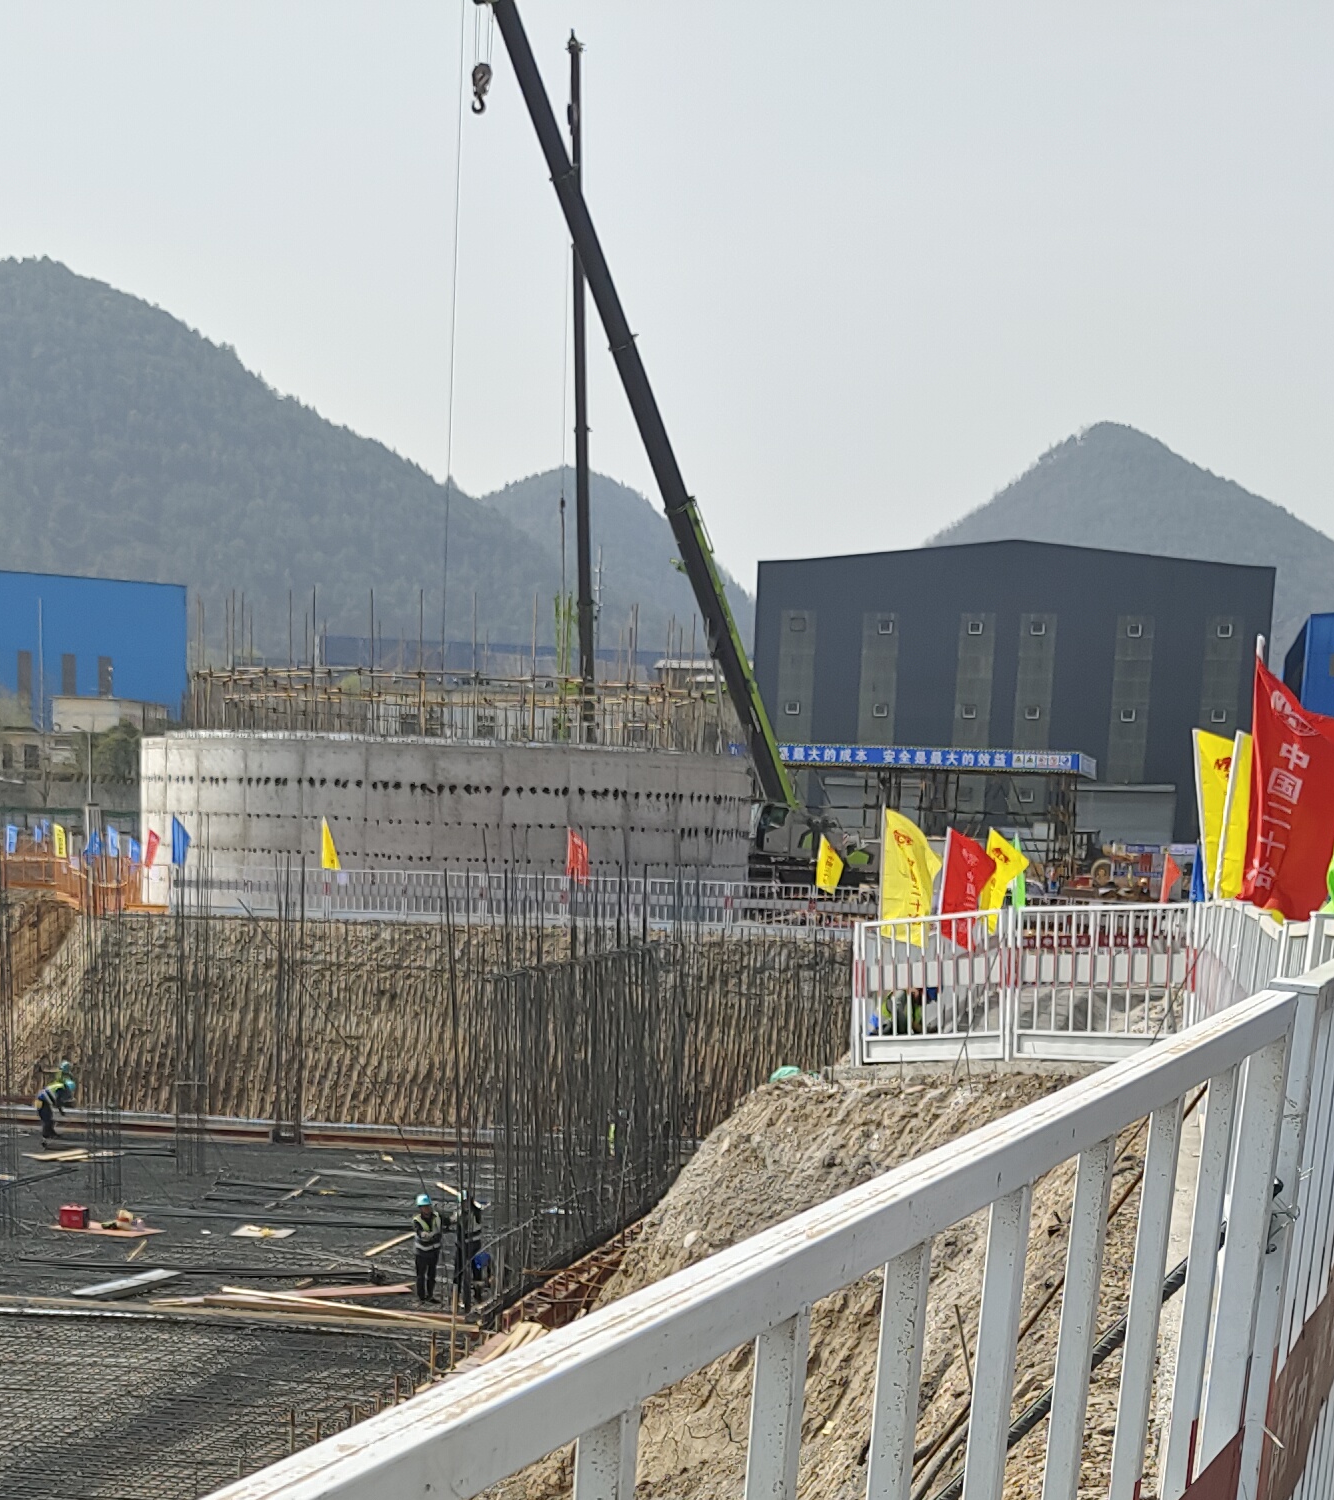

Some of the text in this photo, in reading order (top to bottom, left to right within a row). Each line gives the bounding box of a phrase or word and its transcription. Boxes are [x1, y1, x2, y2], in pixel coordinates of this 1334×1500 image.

[882, 750, 1007, 768] 安全是最大的效益
